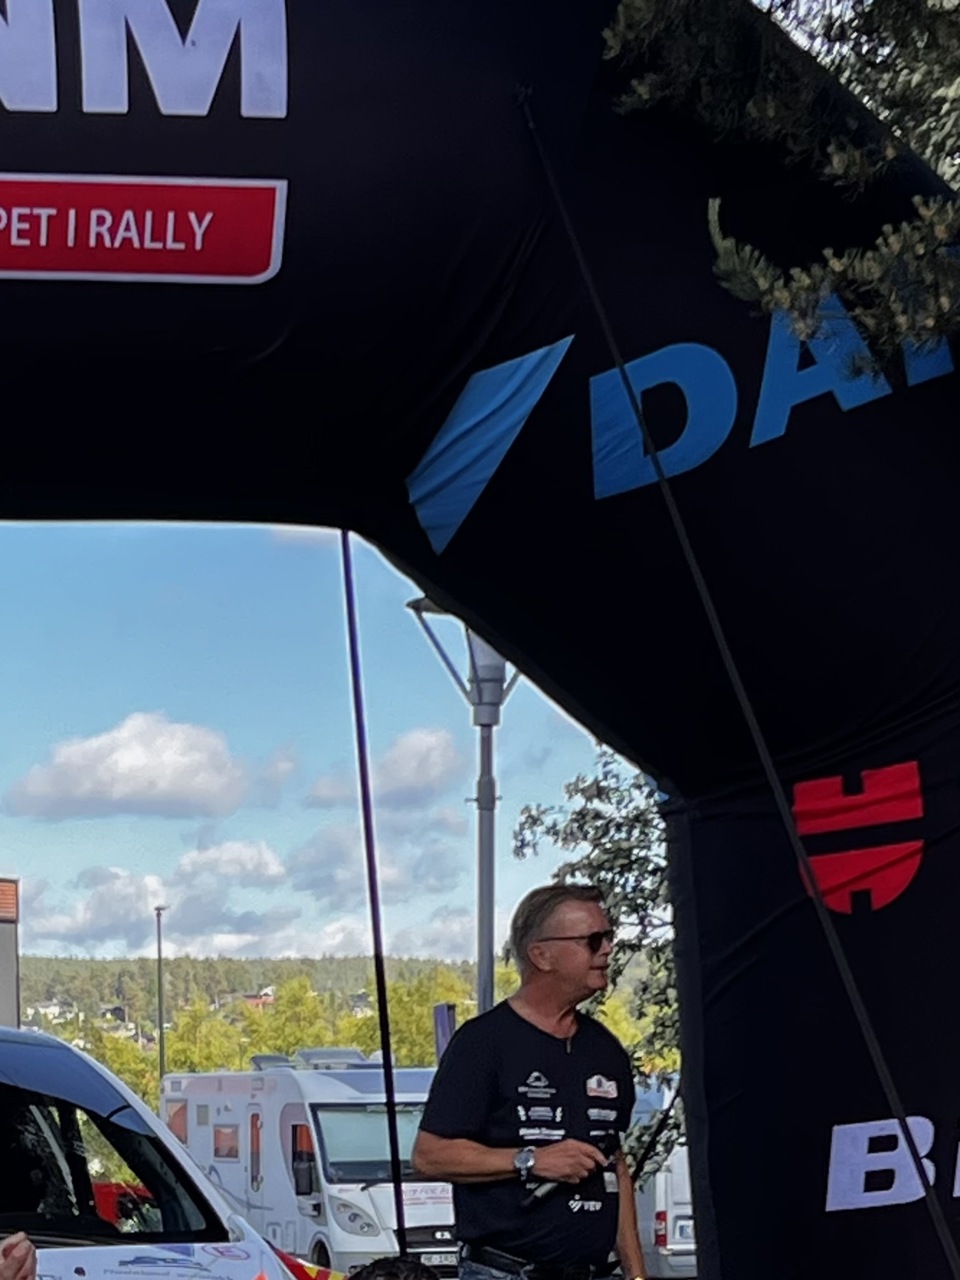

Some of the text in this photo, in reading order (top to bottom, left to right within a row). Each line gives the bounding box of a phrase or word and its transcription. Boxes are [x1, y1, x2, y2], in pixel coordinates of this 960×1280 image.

[66, 209, 77, 248] I
[87, 210, 215, 252] RALLY
[589, 284, 956, 501] DA
